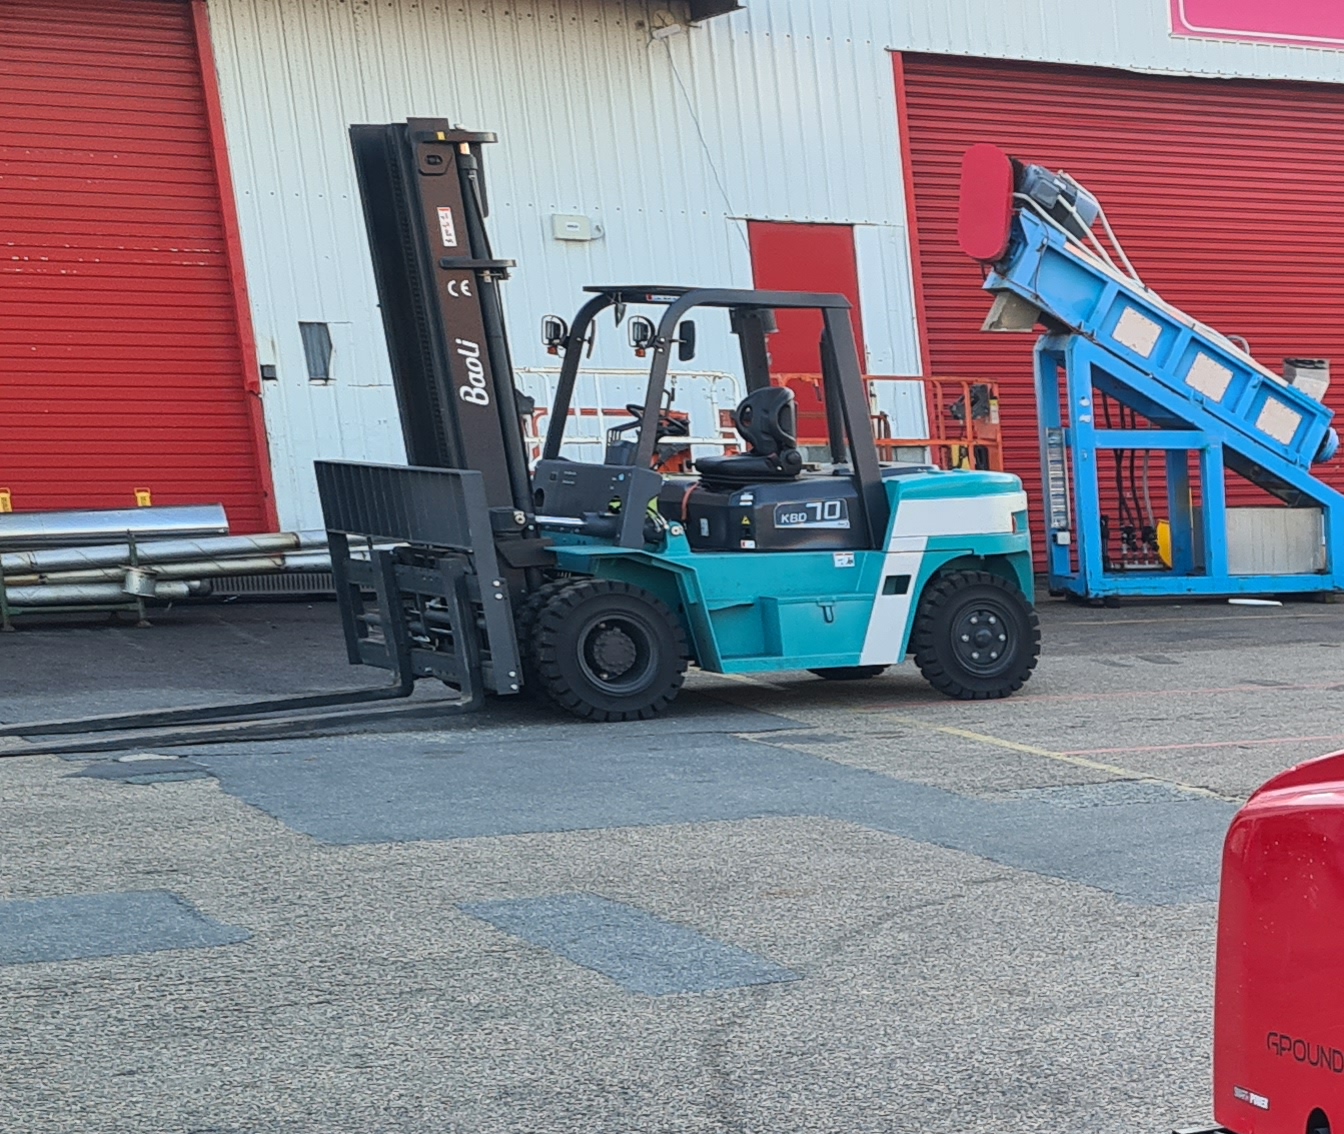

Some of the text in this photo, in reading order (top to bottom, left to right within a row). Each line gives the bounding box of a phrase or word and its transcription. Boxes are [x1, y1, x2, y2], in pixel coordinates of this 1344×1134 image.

[455, 338, 489, 406] Baoli
[781, 501, 841, 524] KBD 70
